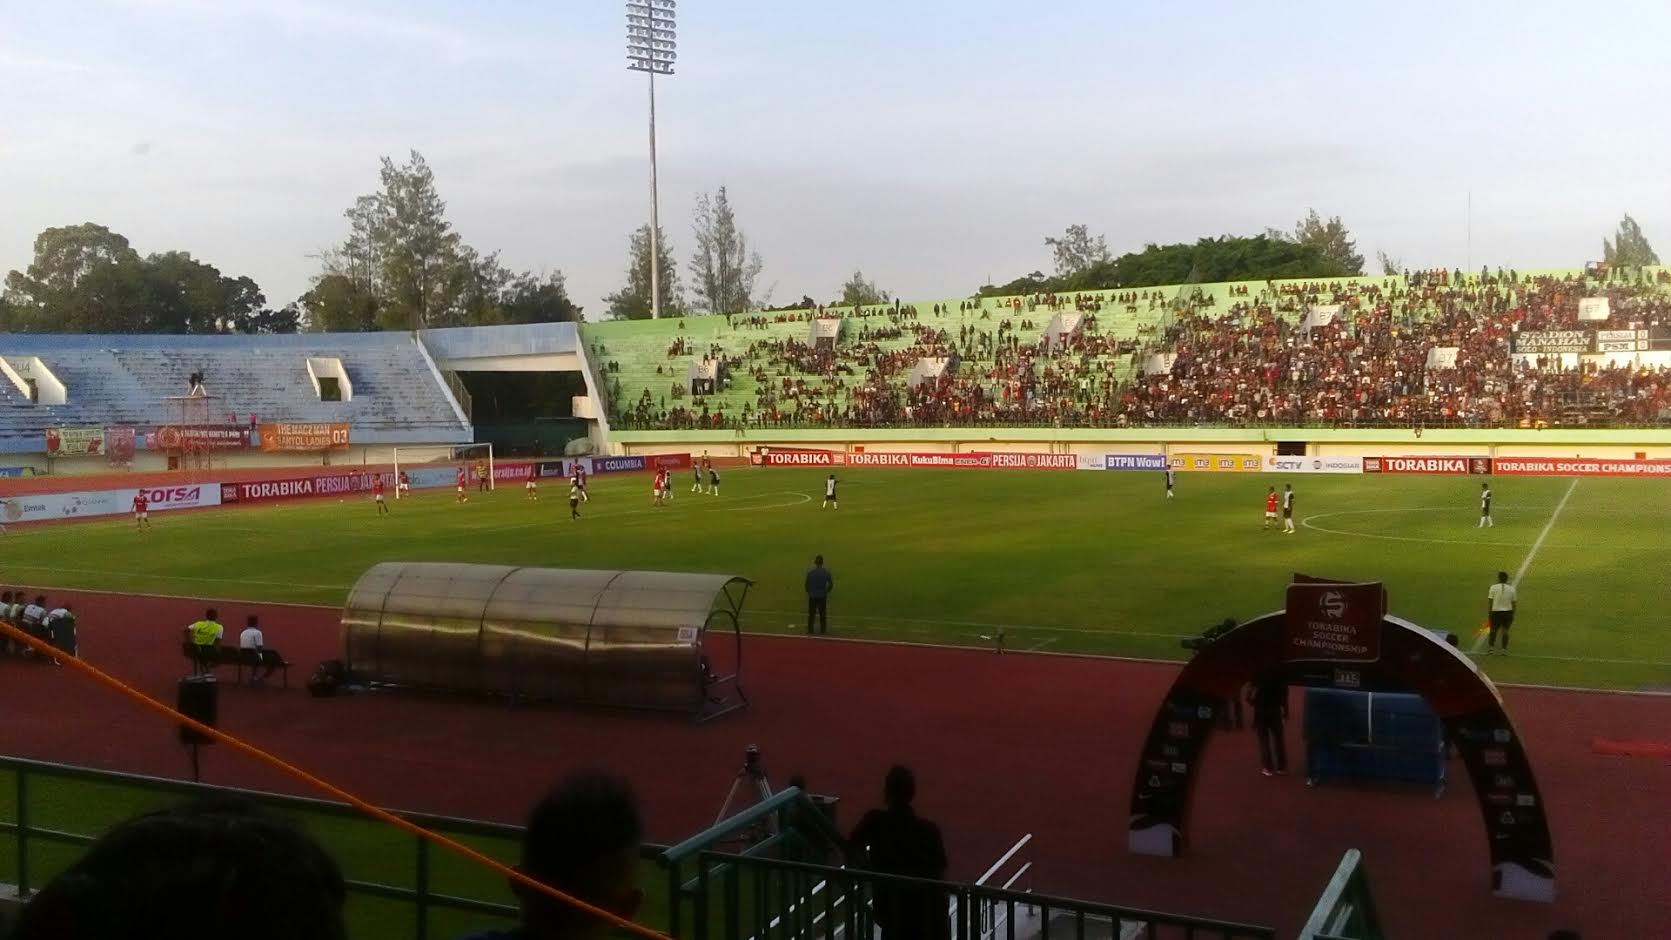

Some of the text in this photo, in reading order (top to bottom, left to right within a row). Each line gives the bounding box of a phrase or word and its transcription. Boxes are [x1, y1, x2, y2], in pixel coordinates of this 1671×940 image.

[1519, 330, 1585, 339] STADION
[1515, 338, 1591, 346] MANAHAN
[1603, 343, 1629, 351] PSM
[333, 430, 348, 444] 03
[768, 453, 830, 464] TORABIKA
[848, 454, 909, 465] TORABIKA
[992, 454, 1026, 467] PERSIJA
[1036, 455, 1076, 468] JAKARTA
[1107, 456, 1135, 467] BTPN
[1136, 456, 1165, 468] Wow!
[605, 459, 642, 470] COLUMBIA
[1276, 461, 1302, 470] SCTV
[1385, 459, 1465, 472] TORABIKA
[1496, 462, 1555, 472] TORABIKA
[1556, 463, 1600, 472] SOCCER
[242, 480, 313, 498] TORABIKA
[316, 476, 350, 493] PERSIJA
[1307, 621, 1358, 635] TORABIKA
[1312, 630, 1350, 643] SOCCER
[1294, 638, 1368, 654] CHAMPIONSHIP
